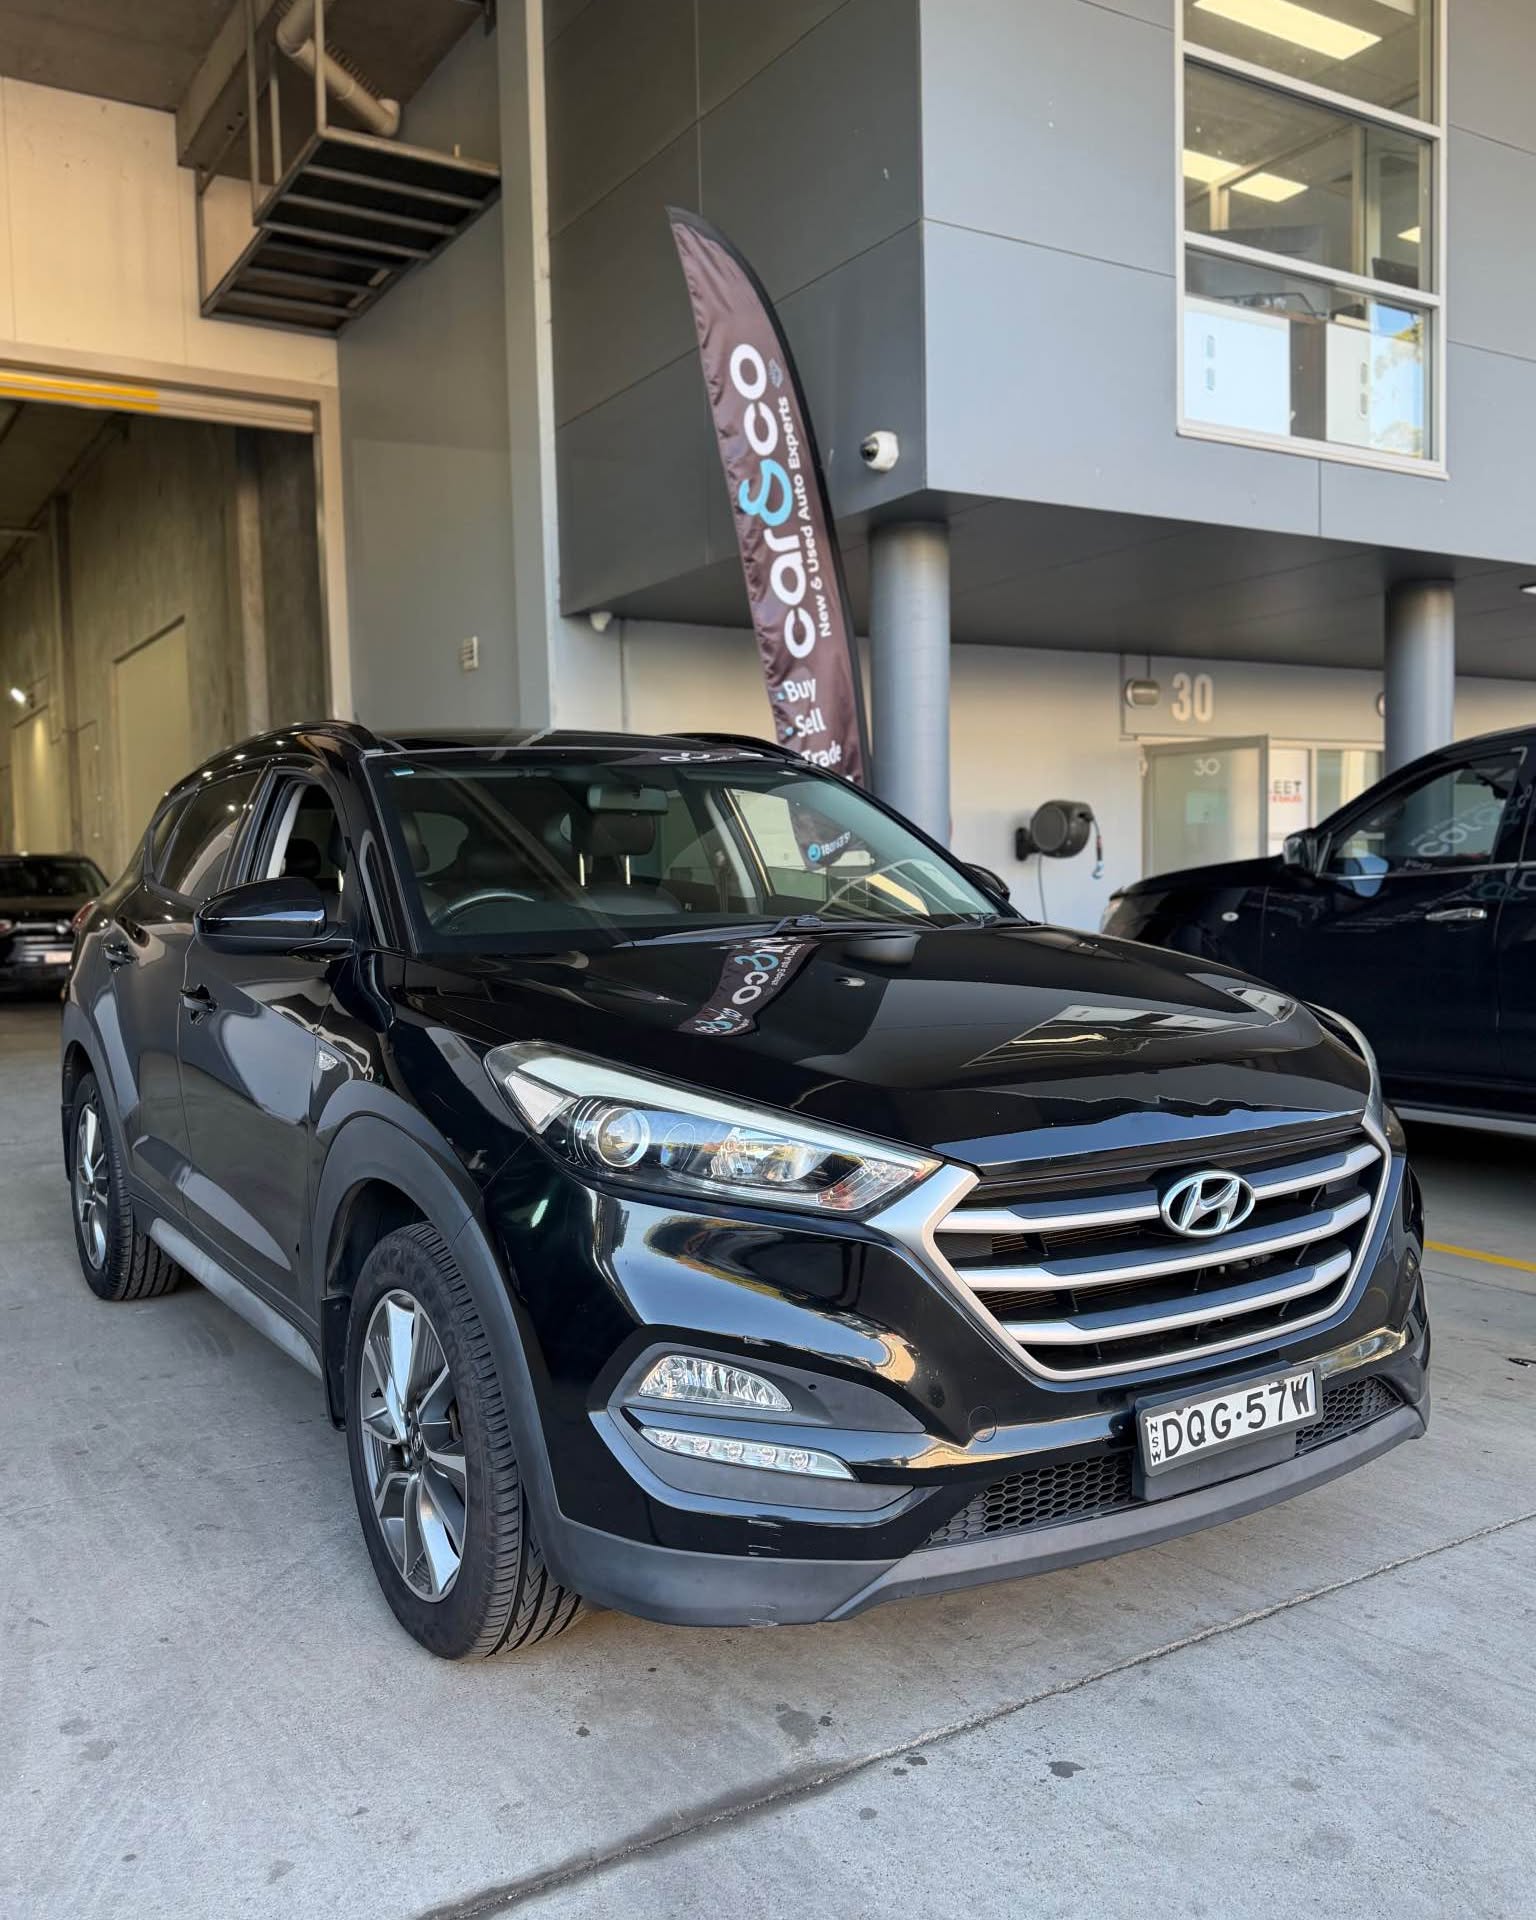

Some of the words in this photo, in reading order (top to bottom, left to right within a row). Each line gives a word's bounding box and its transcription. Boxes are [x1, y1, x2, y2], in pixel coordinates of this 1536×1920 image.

[778, 396, 801, 470] Experts
[730, 343, 816, 659] car&co
[793, 474, 812, 522] Auto
[800, 525, 820, 573] Used
[810, 576, 823, 591] &
[816, 595, 832, 638] New
[782, 678, 817, 702] Buy
[1171, 672, 1214, 722] 30
[795, 707, 827, 737] Sell
[1193, 758, 1221, 777] 30
